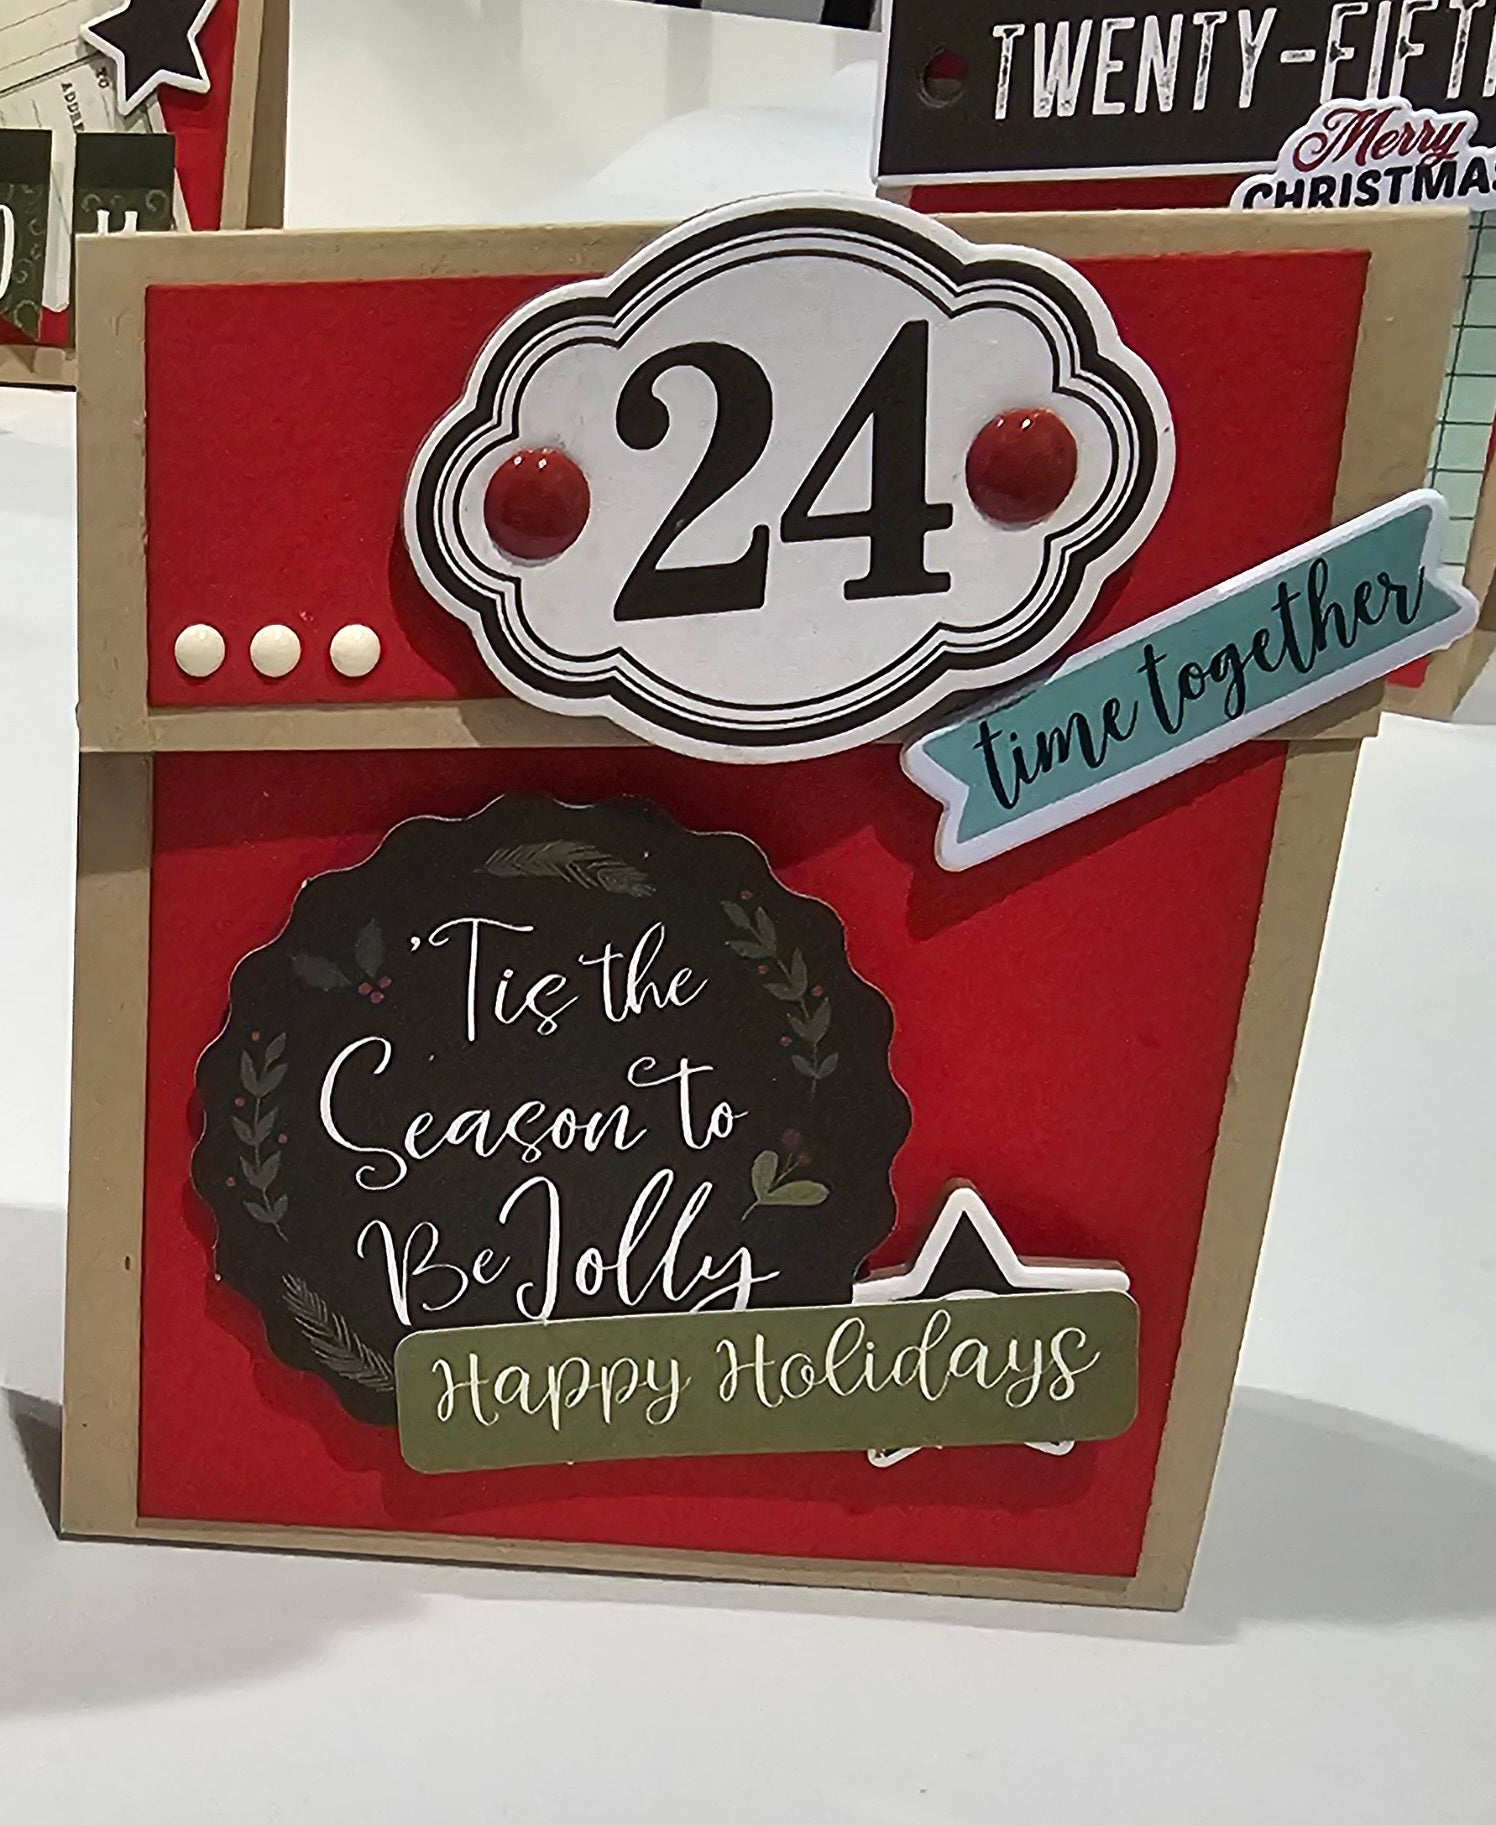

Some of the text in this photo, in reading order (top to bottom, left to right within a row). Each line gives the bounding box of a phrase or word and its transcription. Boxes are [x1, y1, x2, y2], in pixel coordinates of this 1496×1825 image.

[992, 0, 1496, 121] TWENTY-FIFT
[1242, 156, 1496, 210] CHRISTMA
[1292, 106, 1468, 172] Merry
[613, 319, 954, 623] 24
[973, 557, 1426, 810] time together
[408, 916, 708, 1042] 'Tis the
[319, 1035, 750, 1191] Season to
[357, 1168, 780, 1327] Be Jolly
[430, 1307, 1101, 1432] Happy Holidays
